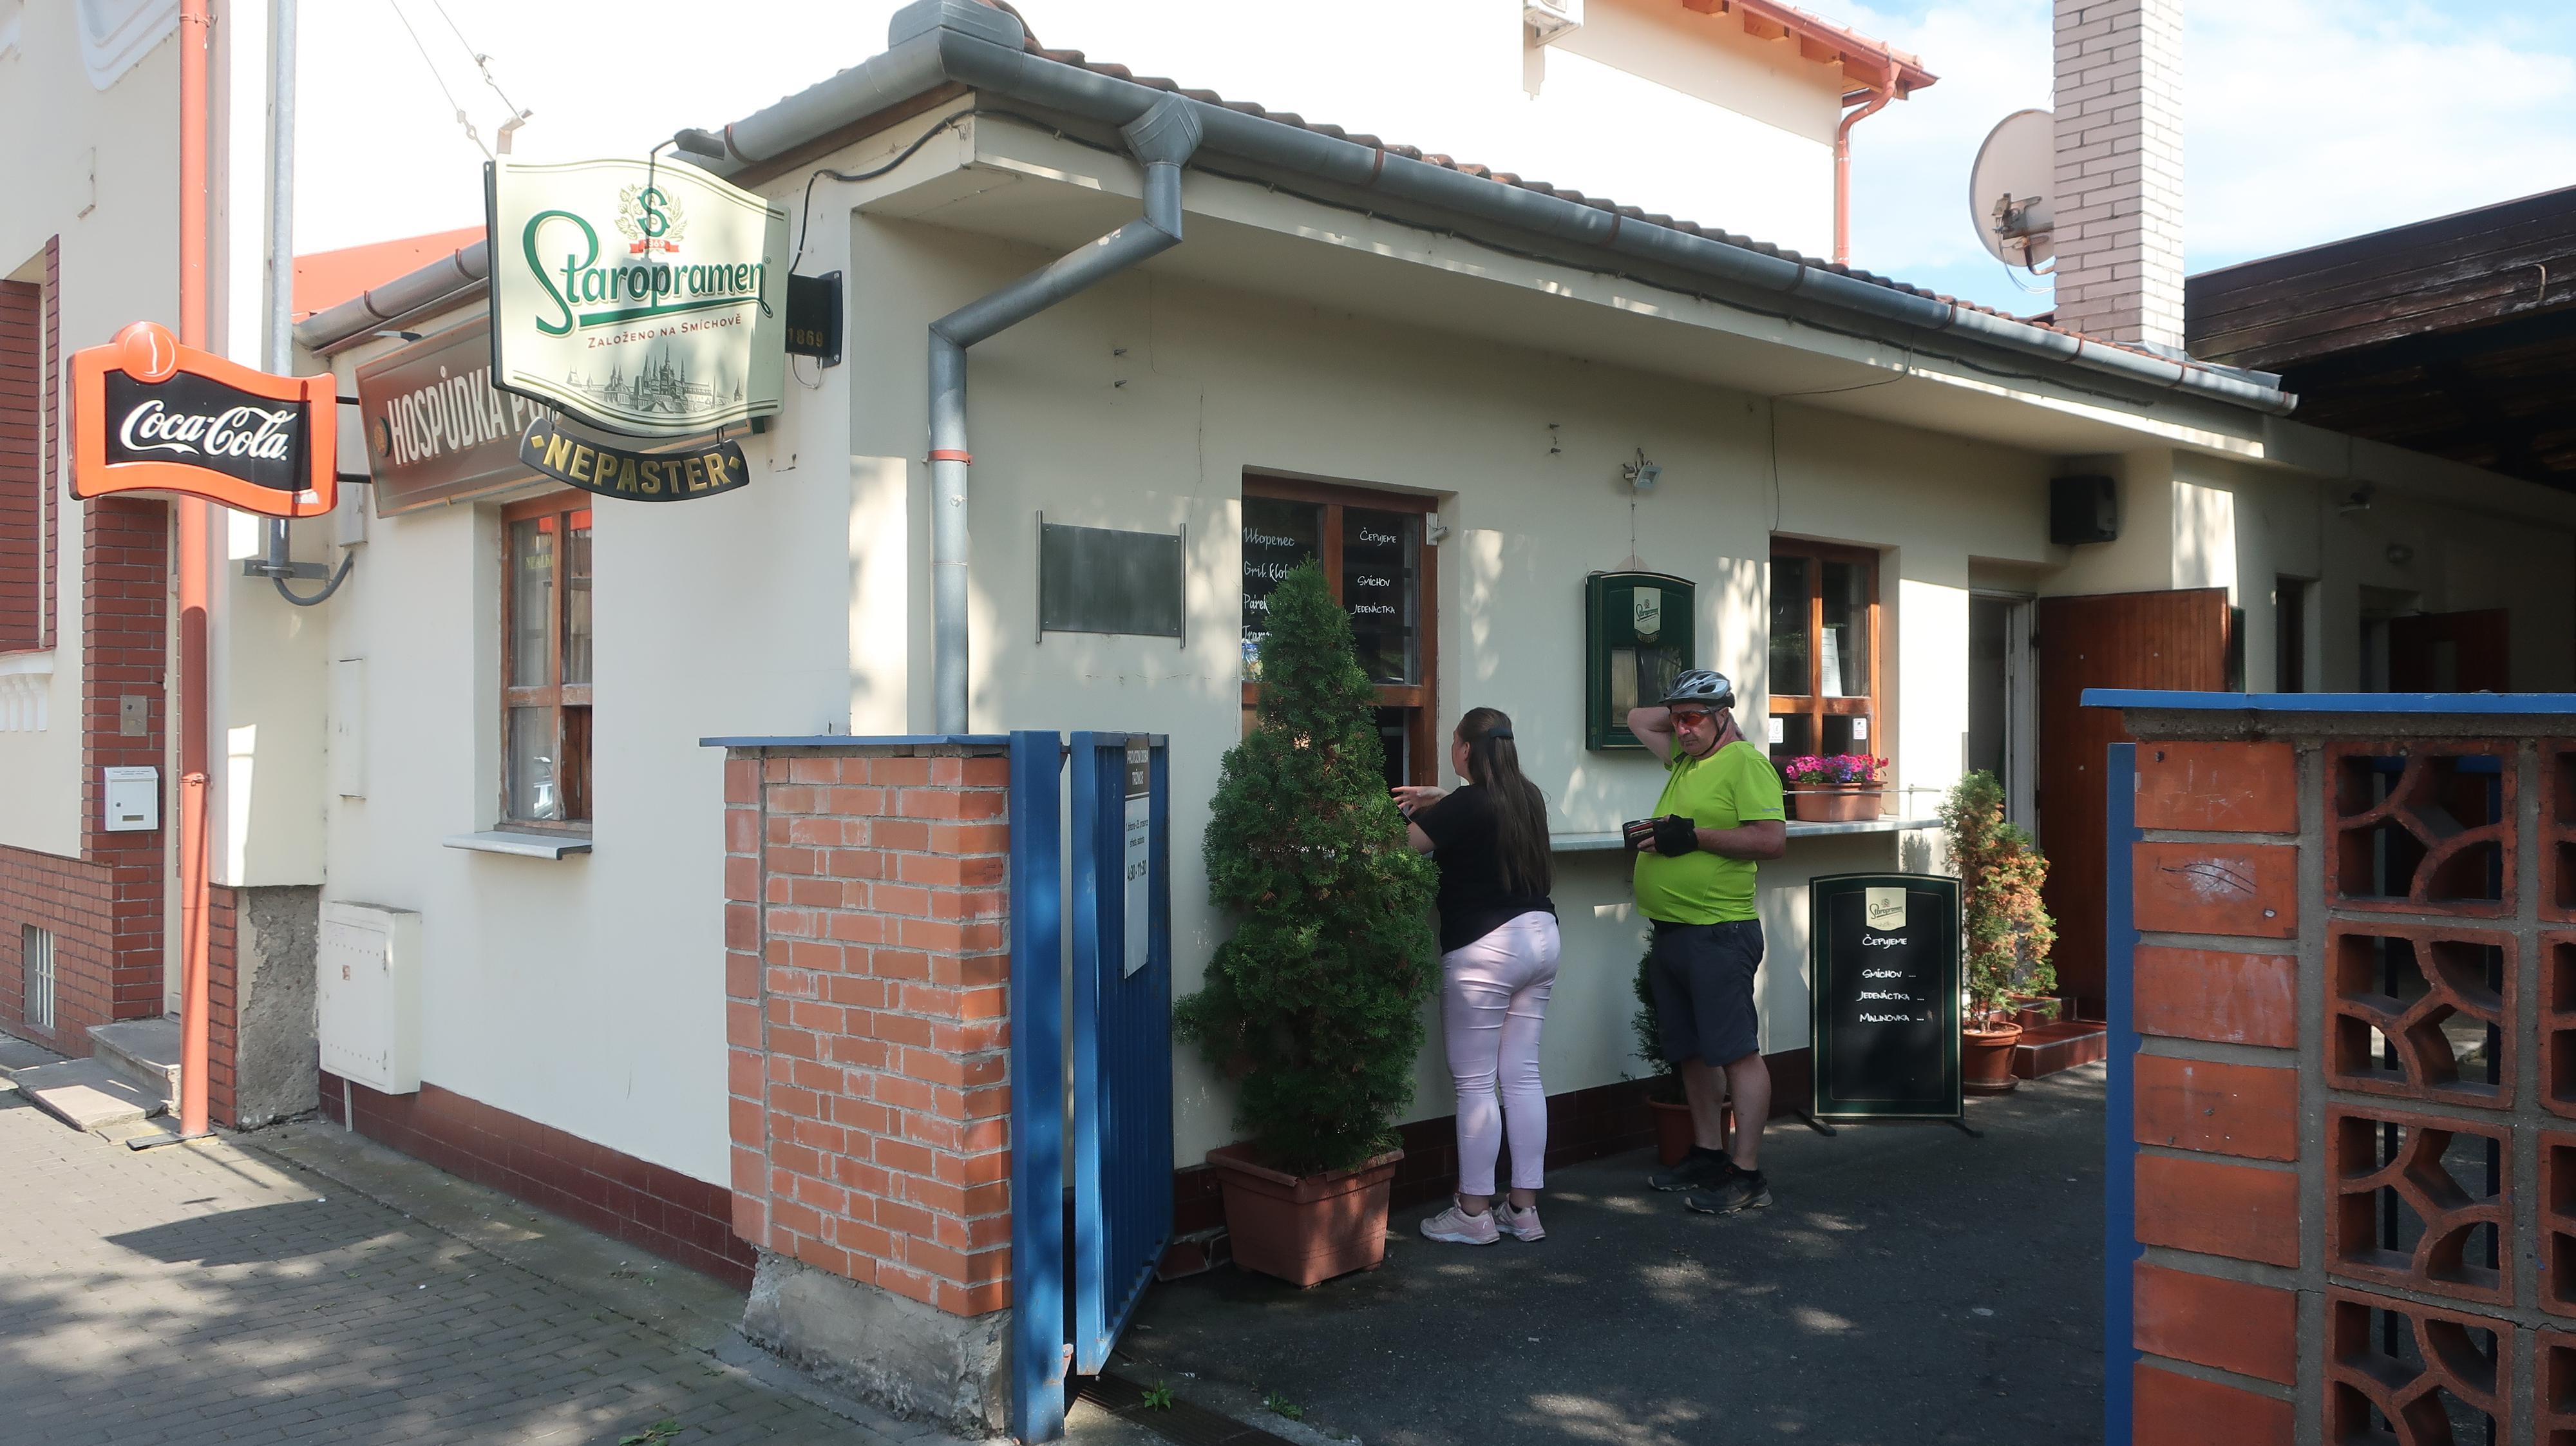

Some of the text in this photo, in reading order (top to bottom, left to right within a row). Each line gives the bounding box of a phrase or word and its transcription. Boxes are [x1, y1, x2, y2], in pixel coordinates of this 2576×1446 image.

[522, 209, 773, 335] Staropramen
[587, 314, 742, 348] ZALOŽENO NA SMÍCHOVĚ
[788, 327, 824, 348] 1869
[387, 365, 507, 465] HOSPŮDKA
[120, 399, 296, 461] Coca-Cola
[543, 430, 732, 494] NEPASTER
[1243, 527, 1295, 551] Utopenec
[1862, 933, 1908, 949] ČEPUJEME
[1862, 968, 1902, 978] SMÍCHOV
[1856, 989, 1911, 1002] JEDENÁCTKA
[1859, 1013, 1910, 1023] MALINOVKA
